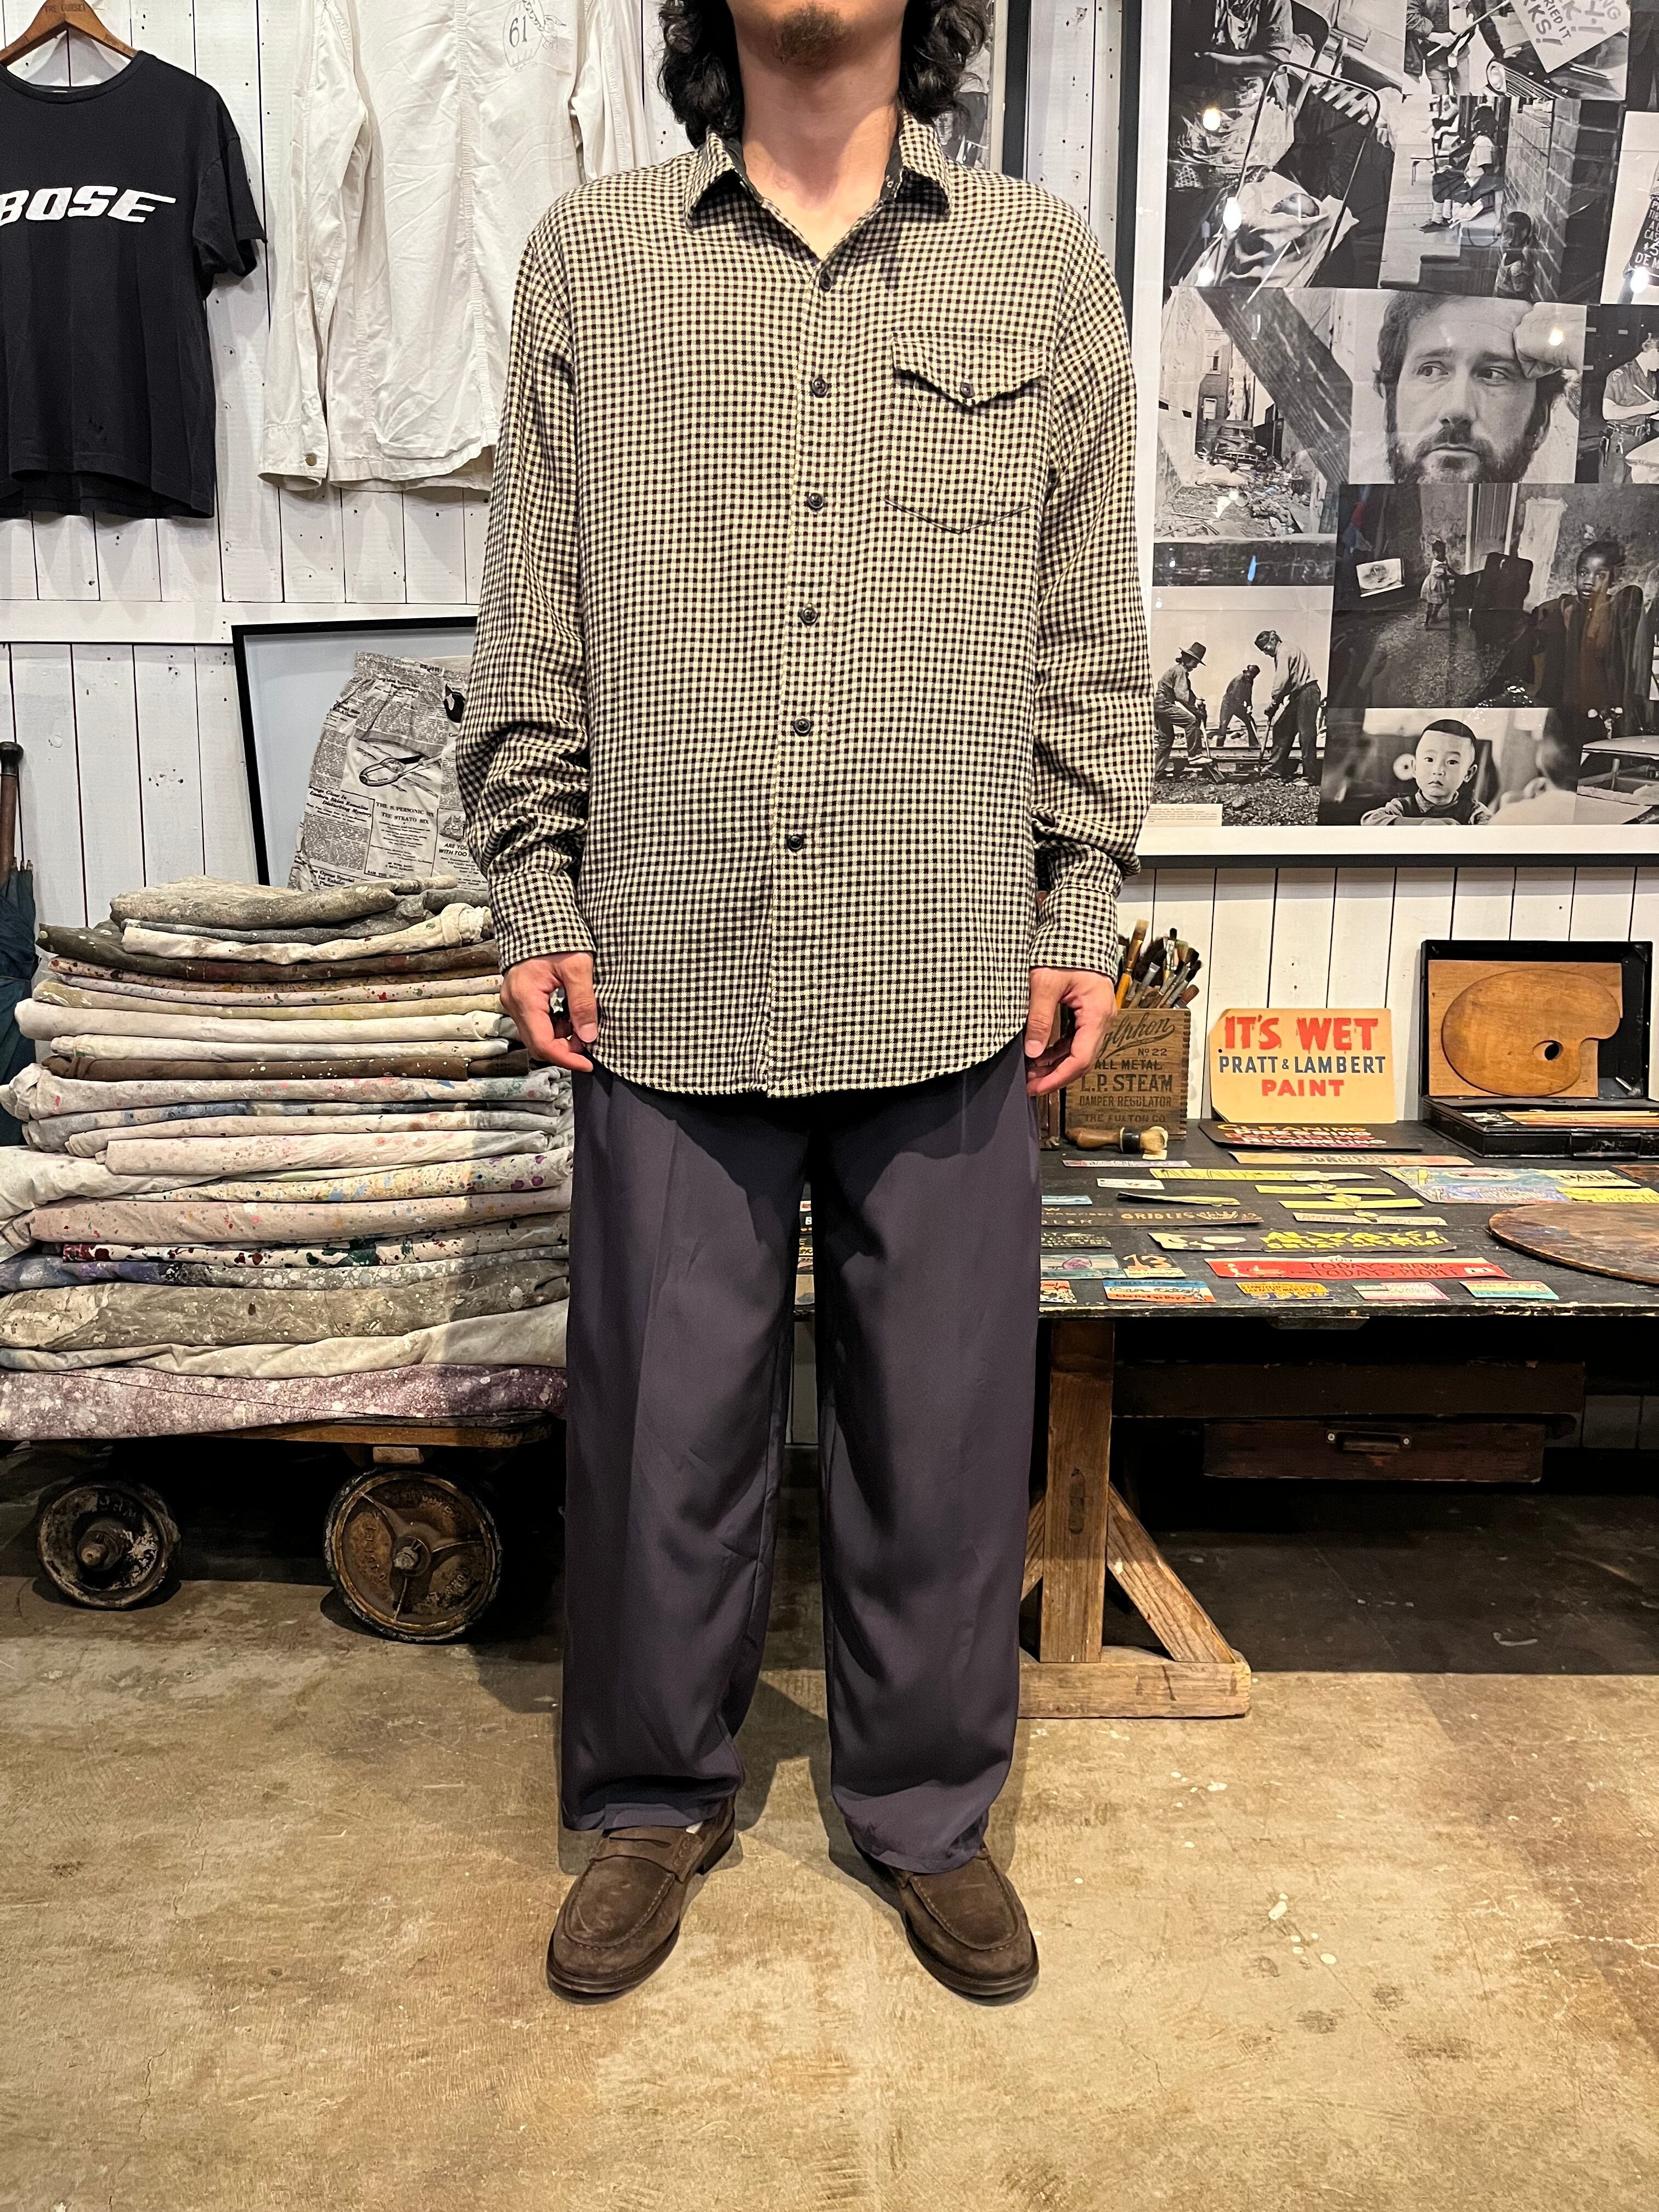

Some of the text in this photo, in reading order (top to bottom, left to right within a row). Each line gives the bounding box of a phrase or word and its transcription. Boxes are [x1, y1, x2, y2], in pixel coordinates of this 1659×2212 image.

[0, 185, 176, 226] BOSE
[1225, 1014, 1378, 1053] IT'S WET
[1152, 1048, 1167, 1057] 22
[1094, 1059, 1162, 1070] ALL METAL
[1220, 1056, 1386, 1073] PRATT & LAMBERT
[1081, 1074, 1172, 1092] L.P. STEAM
[1262, 1079, 1344, 1096] PAINT
[1079, 1096, 1171, 1107] DAMPER REGULATOR
